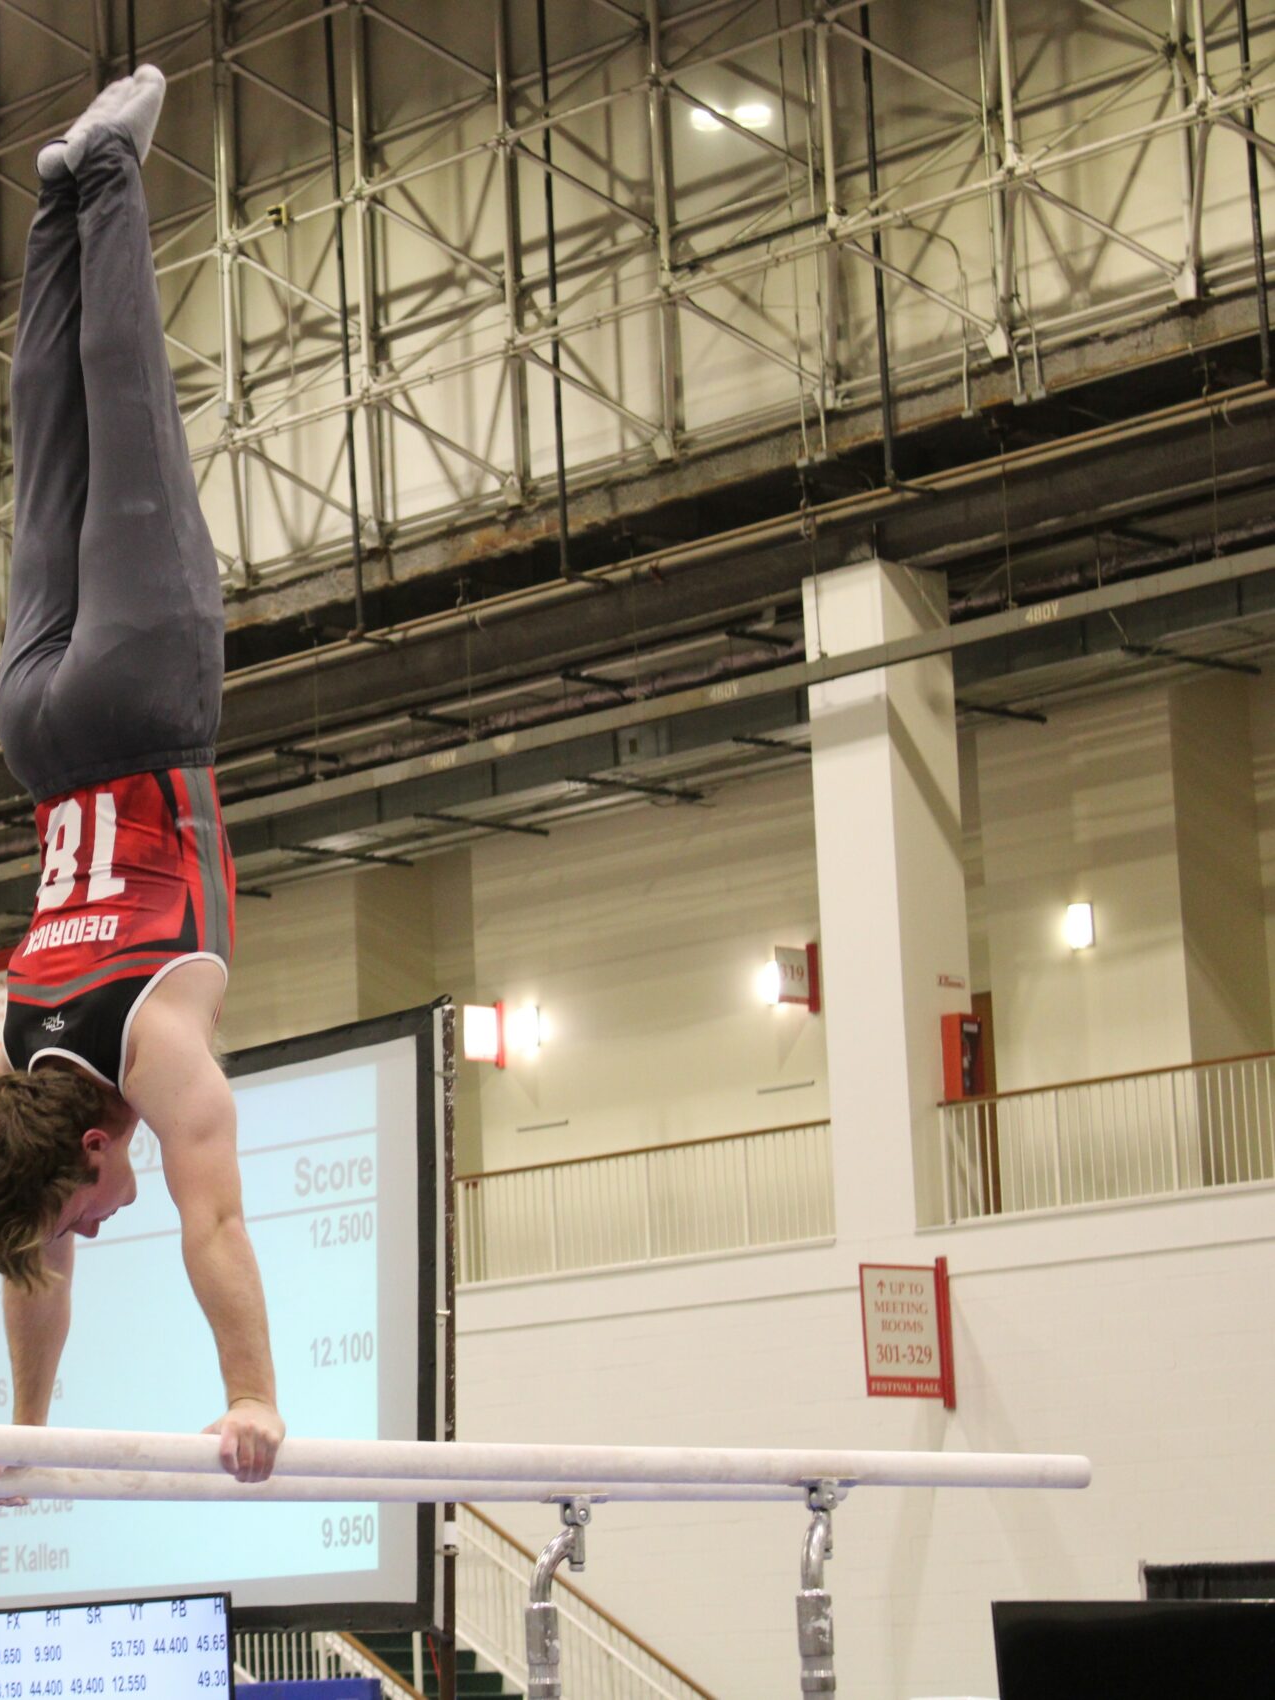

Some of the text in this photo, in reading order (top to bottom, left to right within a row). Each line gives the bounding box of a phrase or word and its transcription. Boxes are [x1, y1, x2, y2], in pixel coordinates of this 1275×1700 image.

[36, 792, 125, 913] 18
[23, 914, 119, 958] DEIDRICK
[294, 1155, 373, 1197] Score
[309, 1210, 373, 1249] 12.500
[889, 1282, 924, 1296] UP TO
[874, 1301, 929, 1315] MEETING
[881, 1319, 924, 1333] ROOMS
[310, 1331, 373, 1368] 12.100
[877, 1344, 933, 1365] 301-329
[871, 1381, 941, 1394] FESTIVAL HALL
[15, 1542, 69, 1573] Kallen
[321, 1513, 374, 1549] 9.950
[7, 1612, 21, 1630] FX
[45, 1609, 61, 1627] PH
[86, 1606, 102, 1624] SR
[129, 1603, 144, 1621] VT
[171, 1600, 187, 1618] PB
[34, 1644, 62, 1662] 9.900
[111, 1639, 146, 1658] 53.750
[153, 1636, 188, 1654] 44.400
[29, 1679, 63, 1697] 44.400
[70, 1676, 104, 1695] 49.400
[112, 1674, 147, 1692] 12.550
